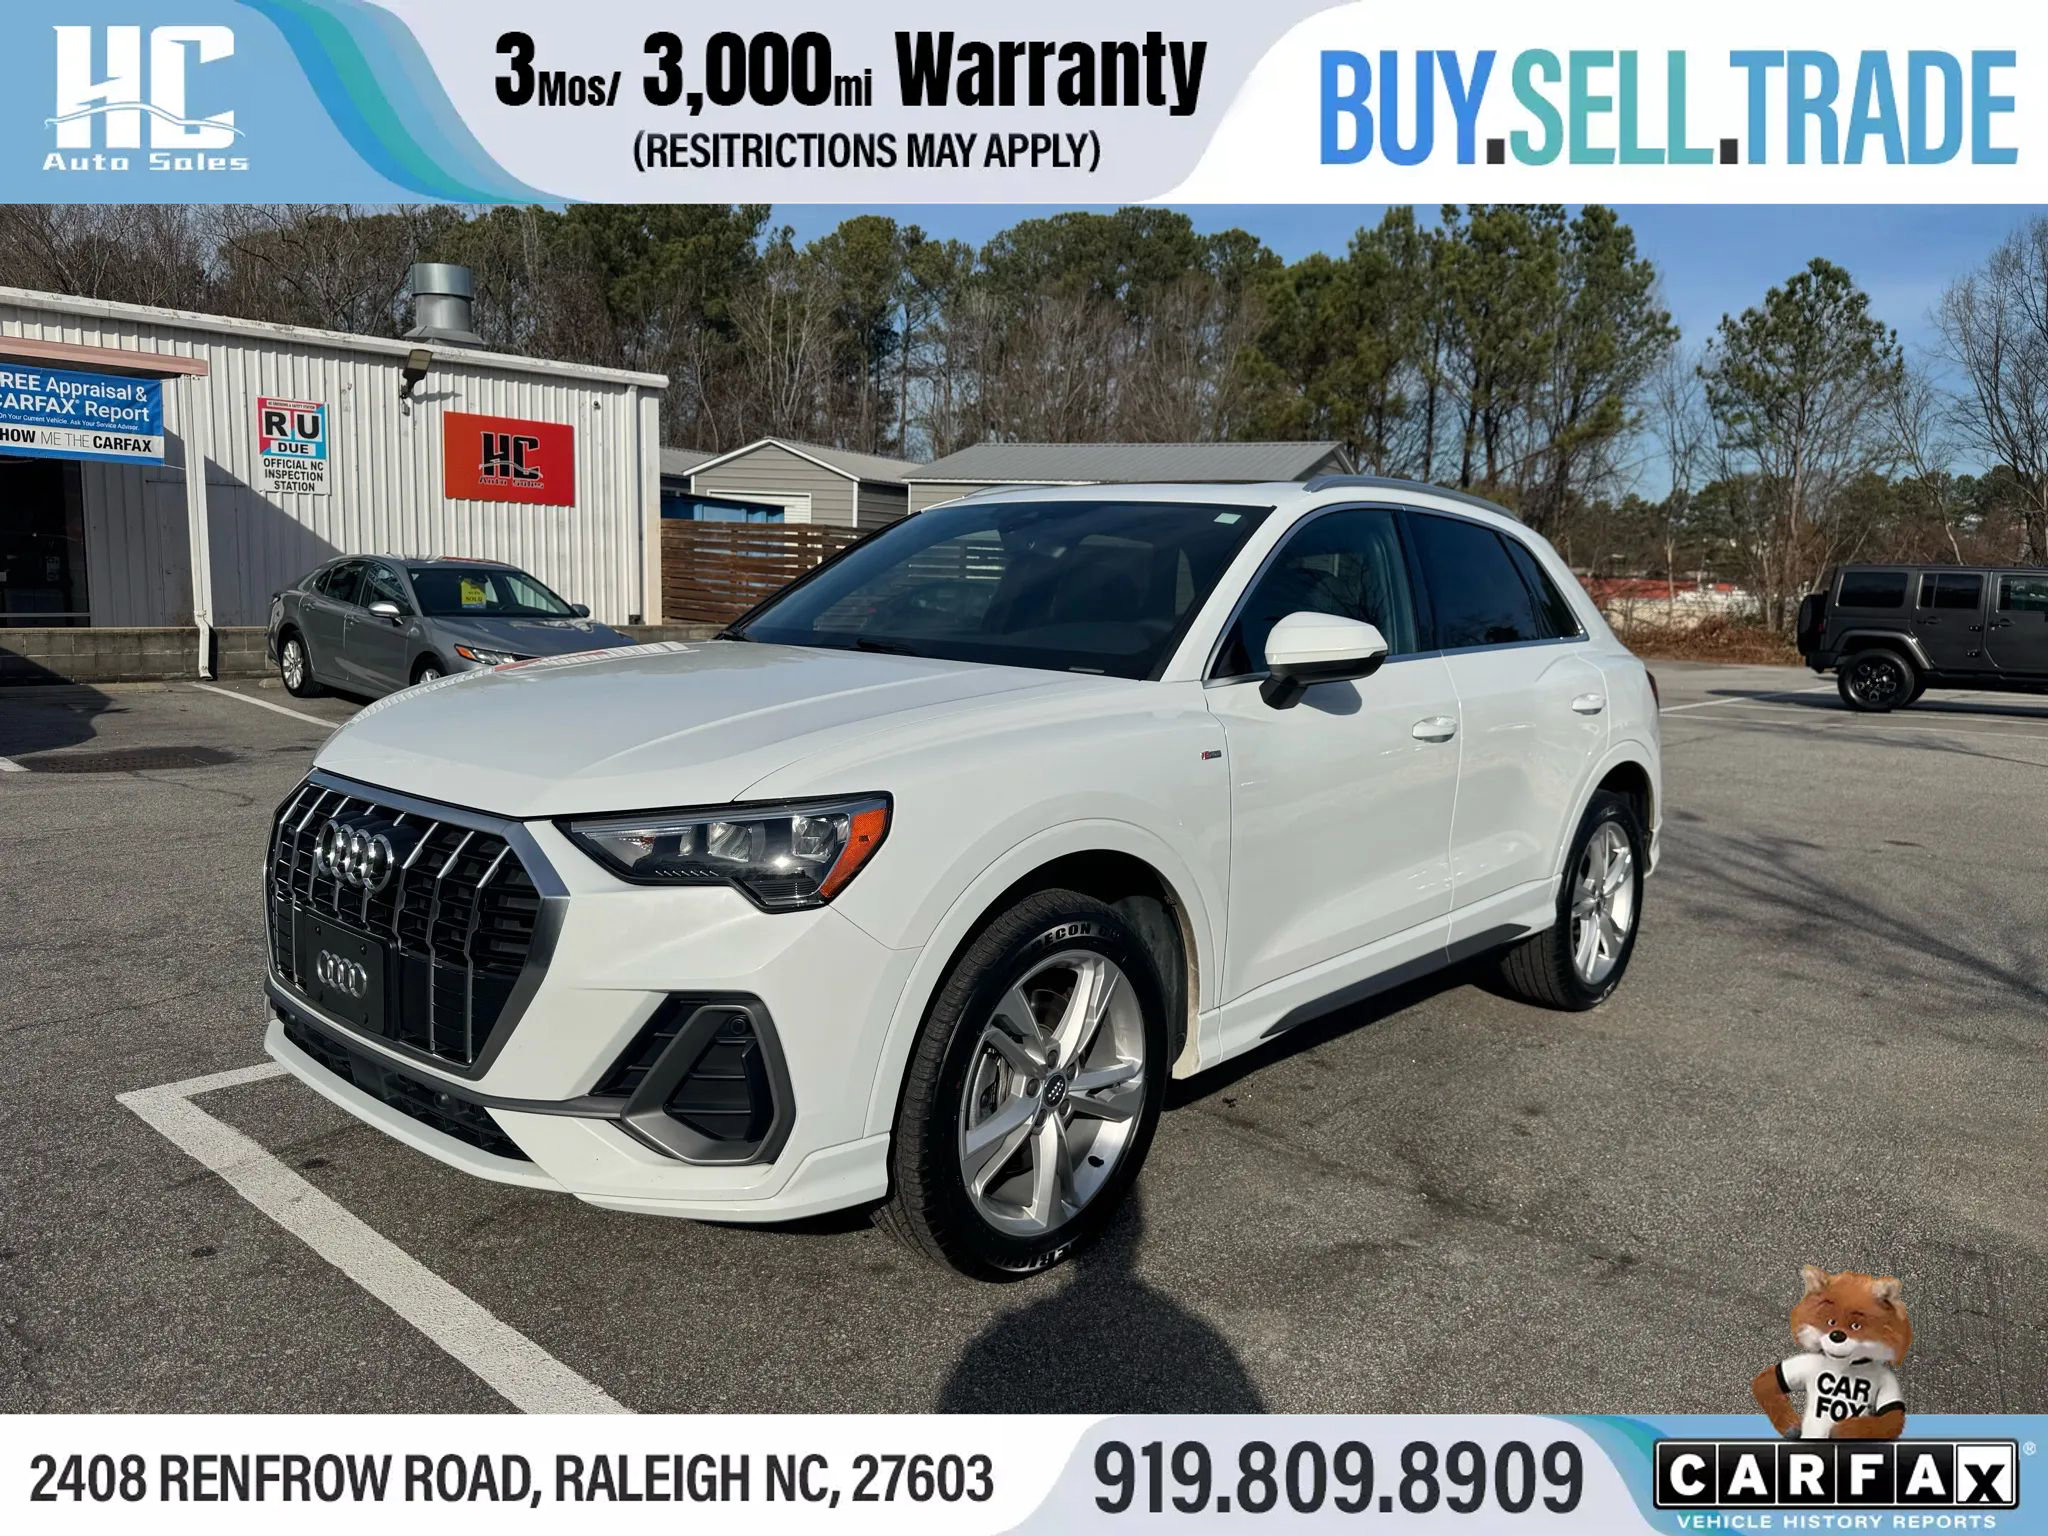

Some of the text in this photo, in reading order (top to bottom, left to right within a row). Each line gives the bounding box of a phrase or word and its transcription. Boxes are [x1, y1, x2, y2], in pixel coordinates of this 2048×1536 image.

[46, 376, 132, 401] Appraisal
[135, 386, 148, 402] &
[85, 400, 150, 423] Report
[23, 414, 45, 422] Current
[96, 421, 117, 429] Service
[41, 431, 62, 446] ME
[64, 432, 90, 448] THE
[93, 435, 153, 453] CARFAX
[278, 442, 309, 454] DUE
[481, 431, 541, 480] HC
[263, 458, 324, 471] OFFICIAL NC
[264, 469, 324, 482] INSPECTION
[274, 480, 315, 492] STATION
